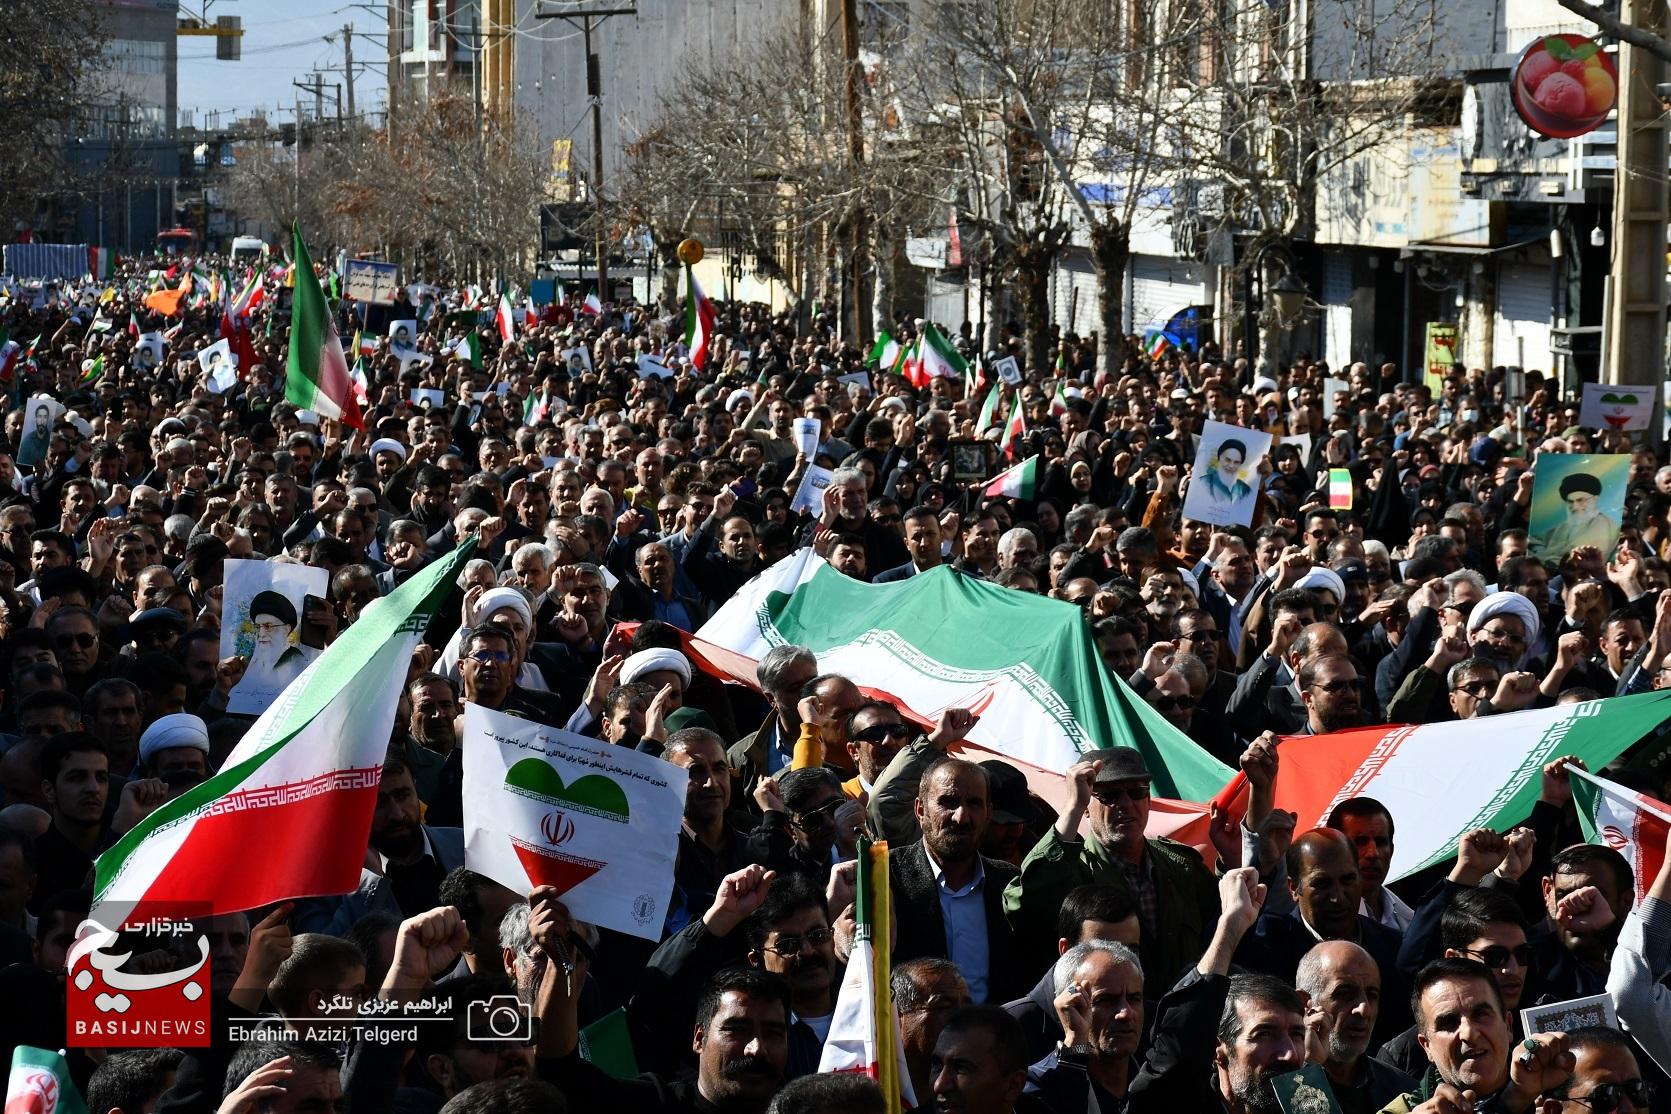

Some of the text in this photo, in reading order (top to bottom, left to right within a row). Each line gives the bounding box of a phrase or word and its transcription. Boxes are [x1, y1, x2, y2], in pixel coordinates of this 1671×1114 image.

[493, 733, 505, 744] پیروز
[505, 736, 519, 746] کشور
[518, 742, 529, 750] این
[546, 749, 566, 759] فداکاری
[565, 754, 578, 763] برای
[588, 760, 606, 771] اینطور
[605, 763, 632, 776] قشرهایش
[631, 771, 643, 780] تمام
[650, 778, 668, 788] کشوری
